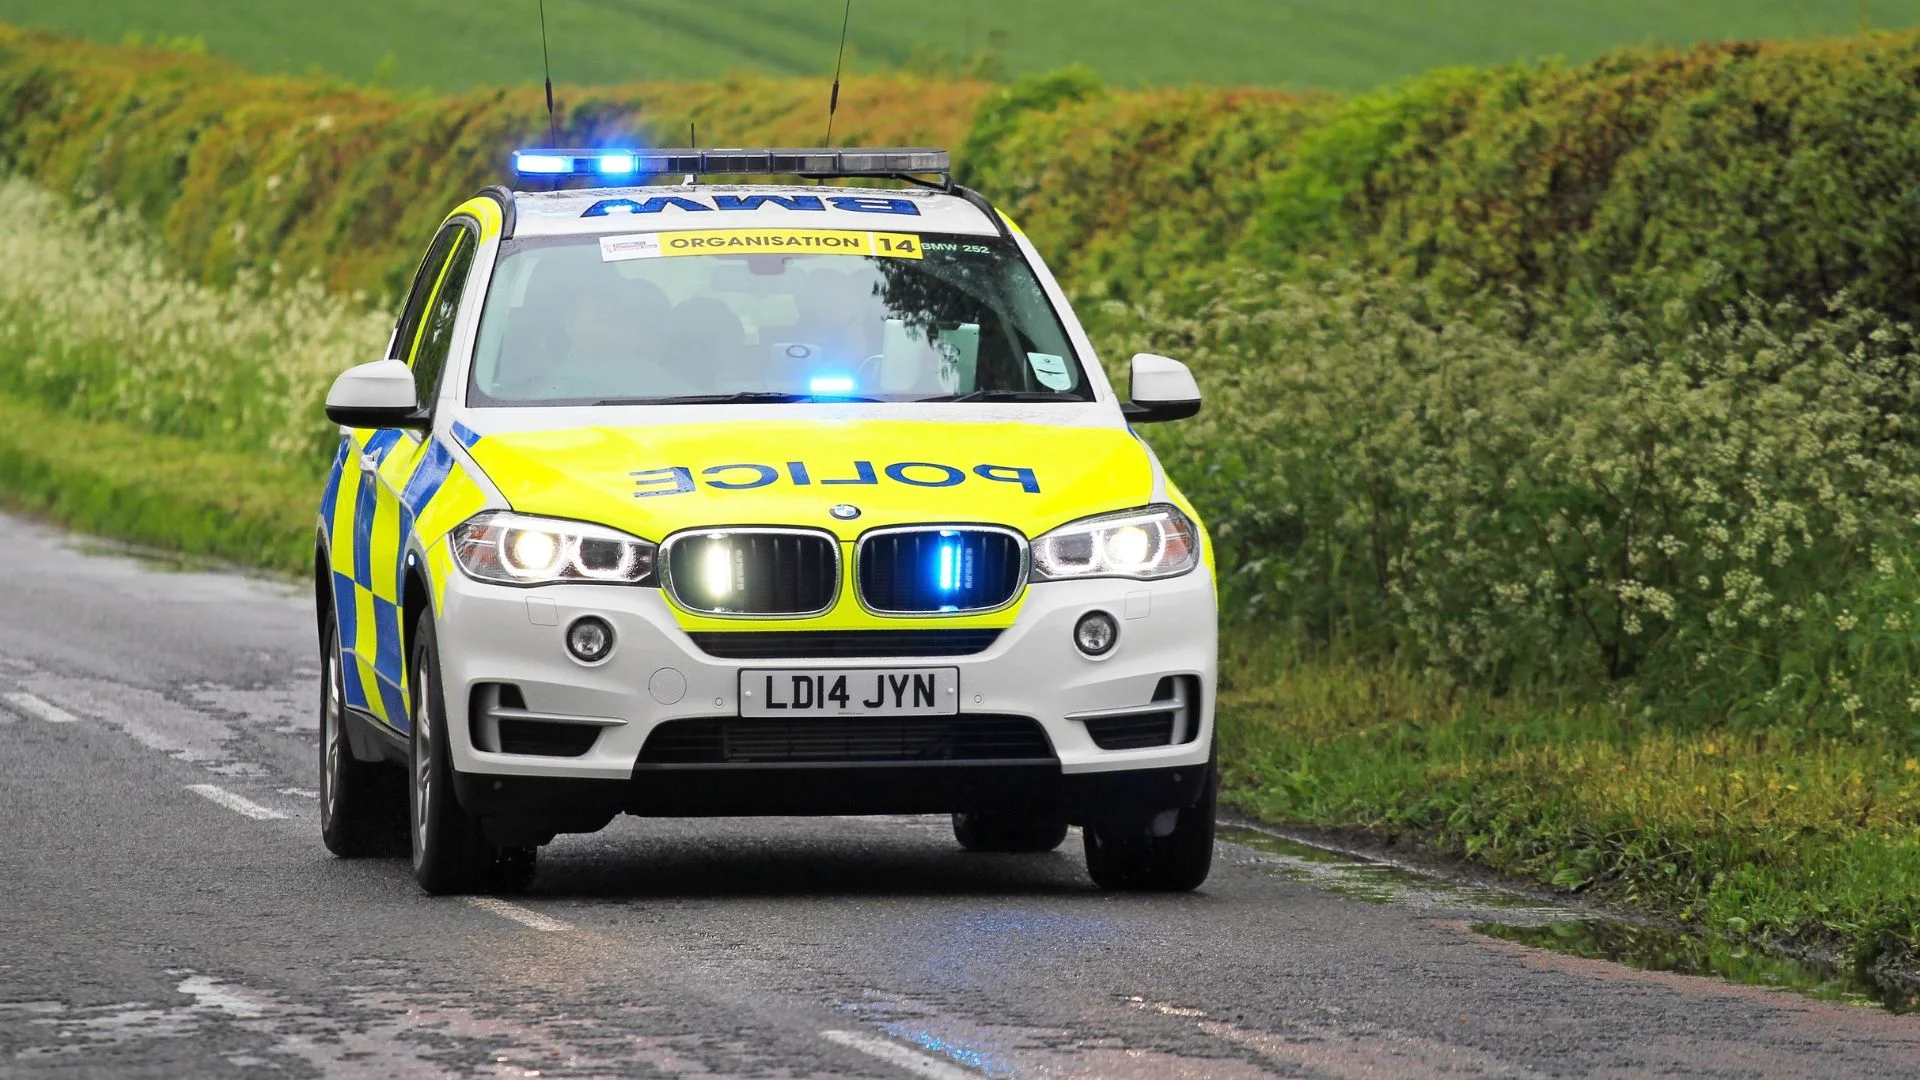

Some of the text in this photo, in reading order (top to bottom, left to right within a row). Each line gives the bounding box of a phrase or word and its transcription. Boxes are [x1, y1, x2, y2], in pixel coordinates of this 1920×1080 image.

[580, 195, 922, 217] BMW
[670, 236, 859, 249] ORGANISATION
[878, 238, 915, 252] 14
[921, 242, 990, 254] BMW 252
[766, 674, 935, 709] LD14 JYN
